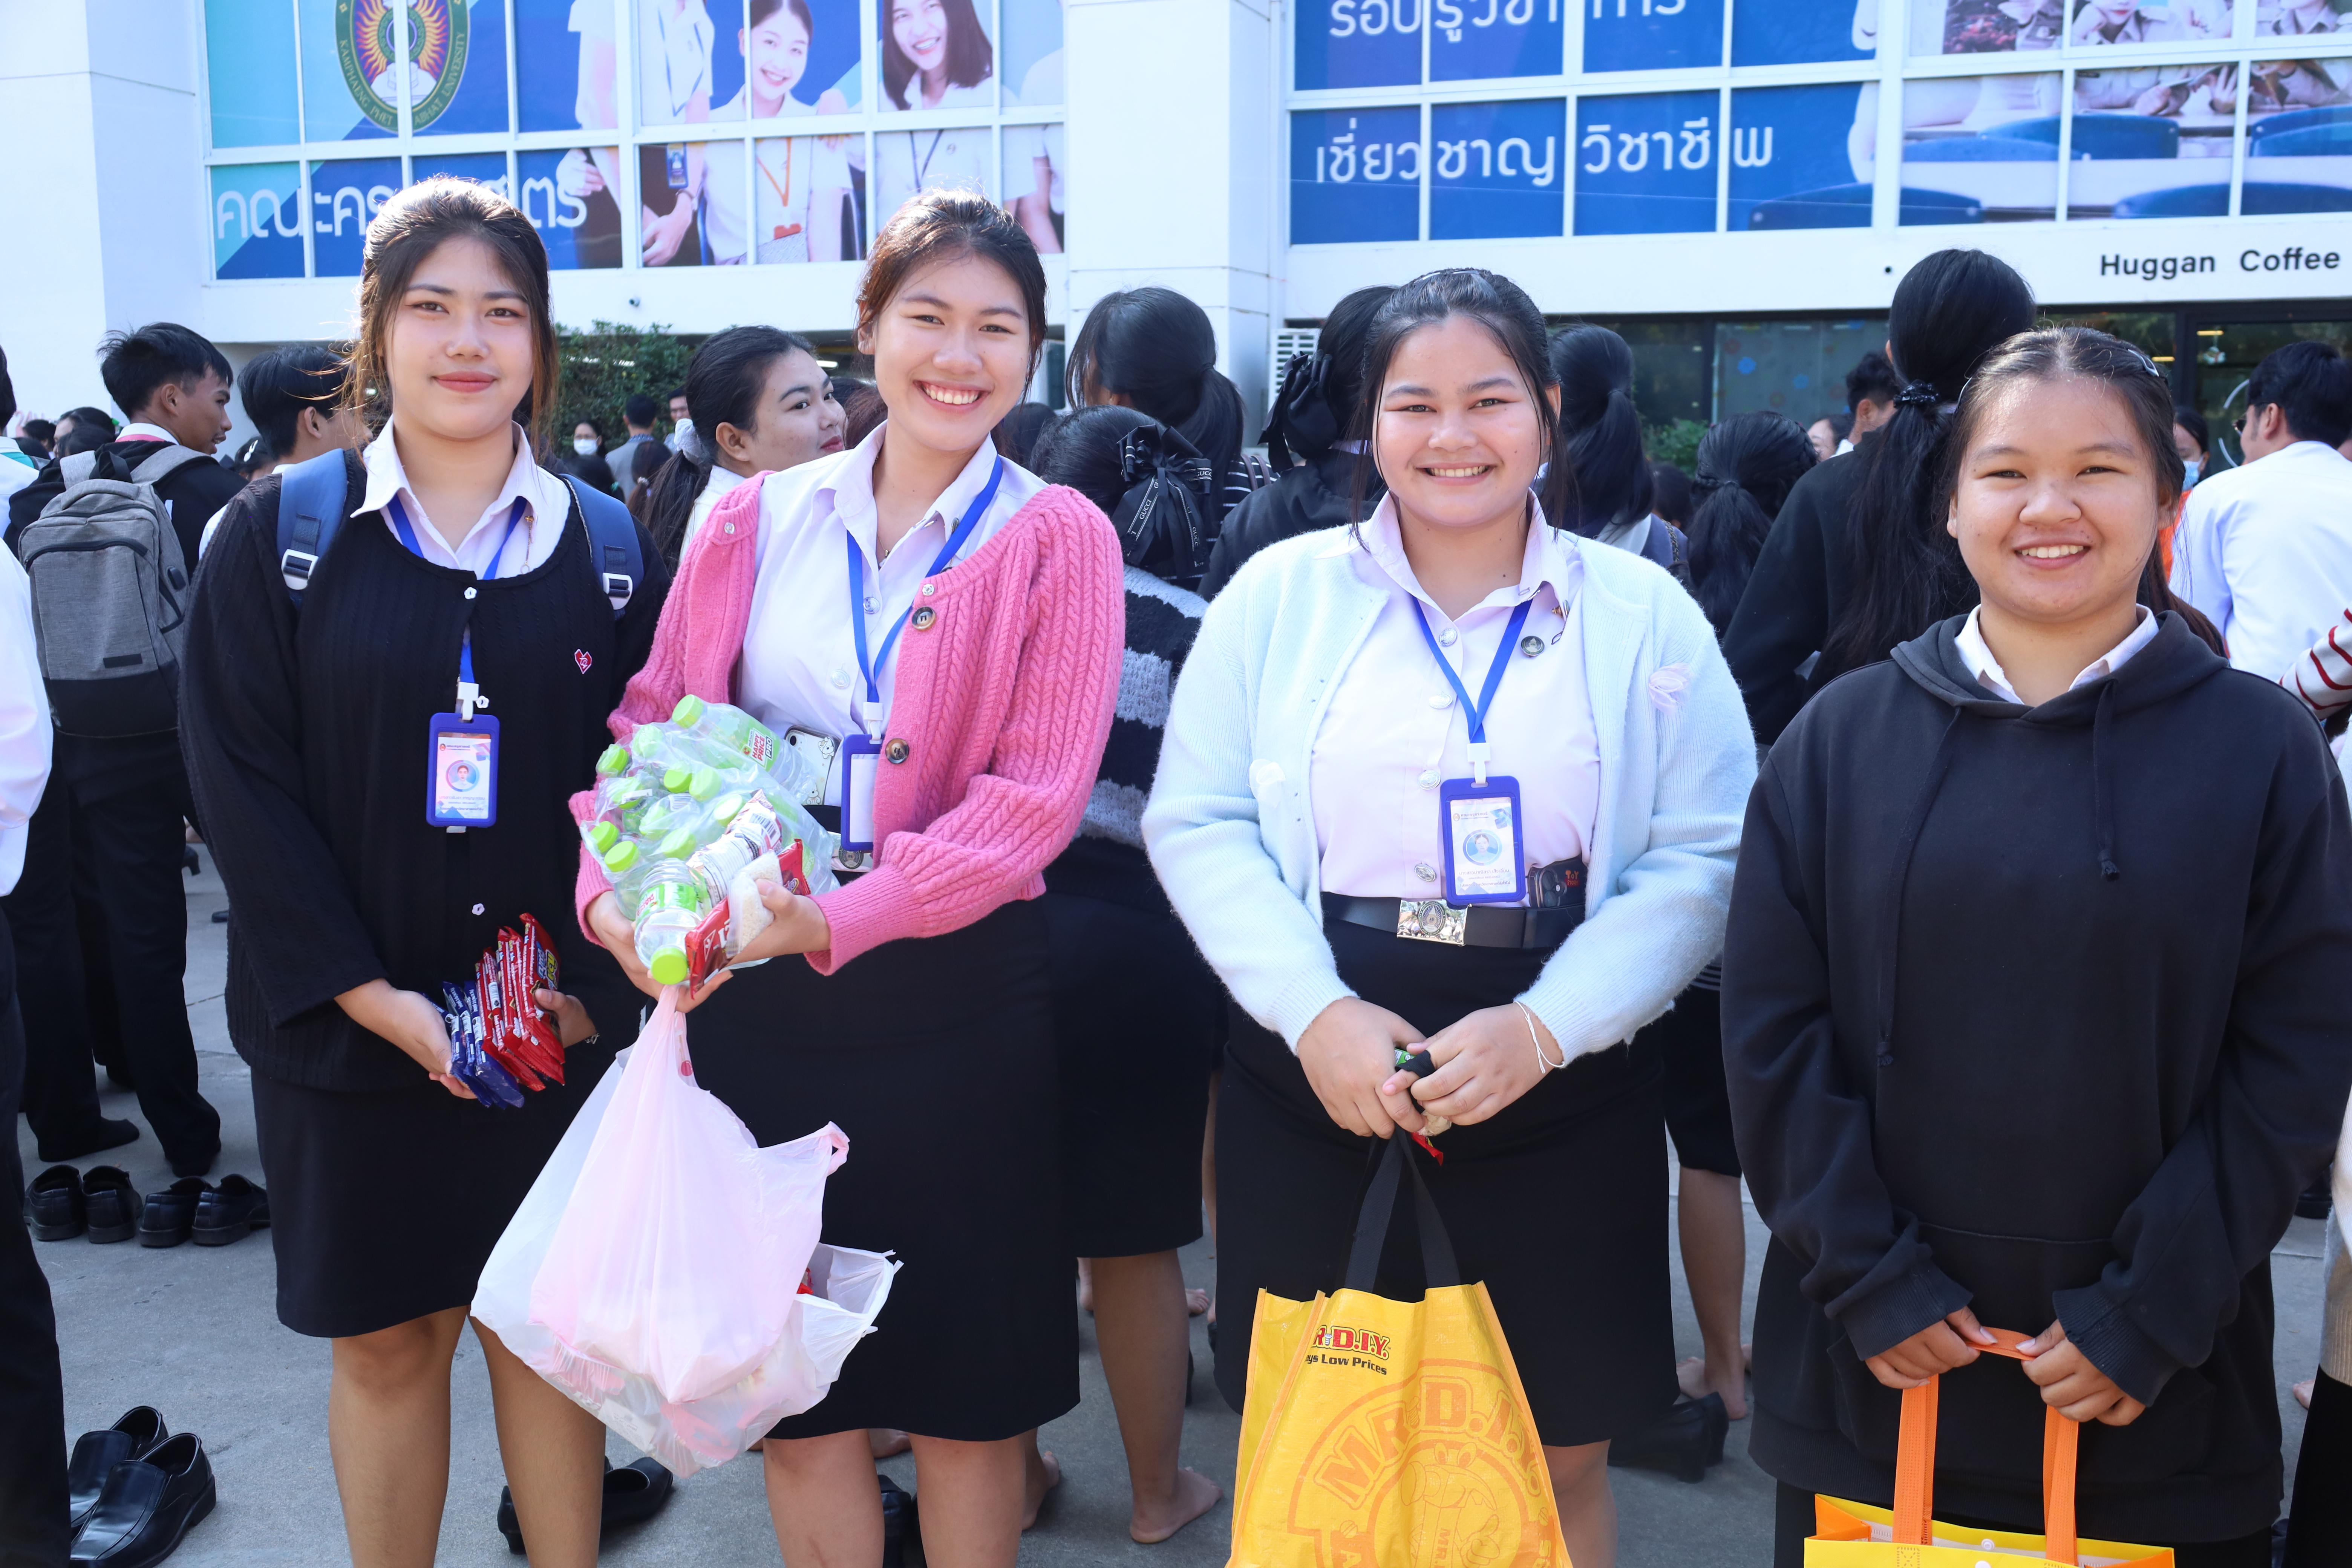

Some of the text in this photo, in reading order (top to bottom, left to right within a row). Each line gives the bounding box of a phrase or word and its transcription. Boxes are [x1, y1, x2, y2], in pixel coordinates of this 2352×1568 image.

[370, 104, 394, 126] PHET
[414, 96, 444, 124] ABHAT
[441, 32, 465, 97] UNIVERSITY
[2101, 247, 2341, 281] Huggan Coffee
[1139, 498, 1153, 520] GUCCI
[752, 733, 760, 759] HAPPY
[757, 735, 765, 761] PRICE
[1565, 870, 1579, 880] TOY
[1321, 1354, 1350, 1366] Low
[1352, 1357, 1387, 1375] Prices
